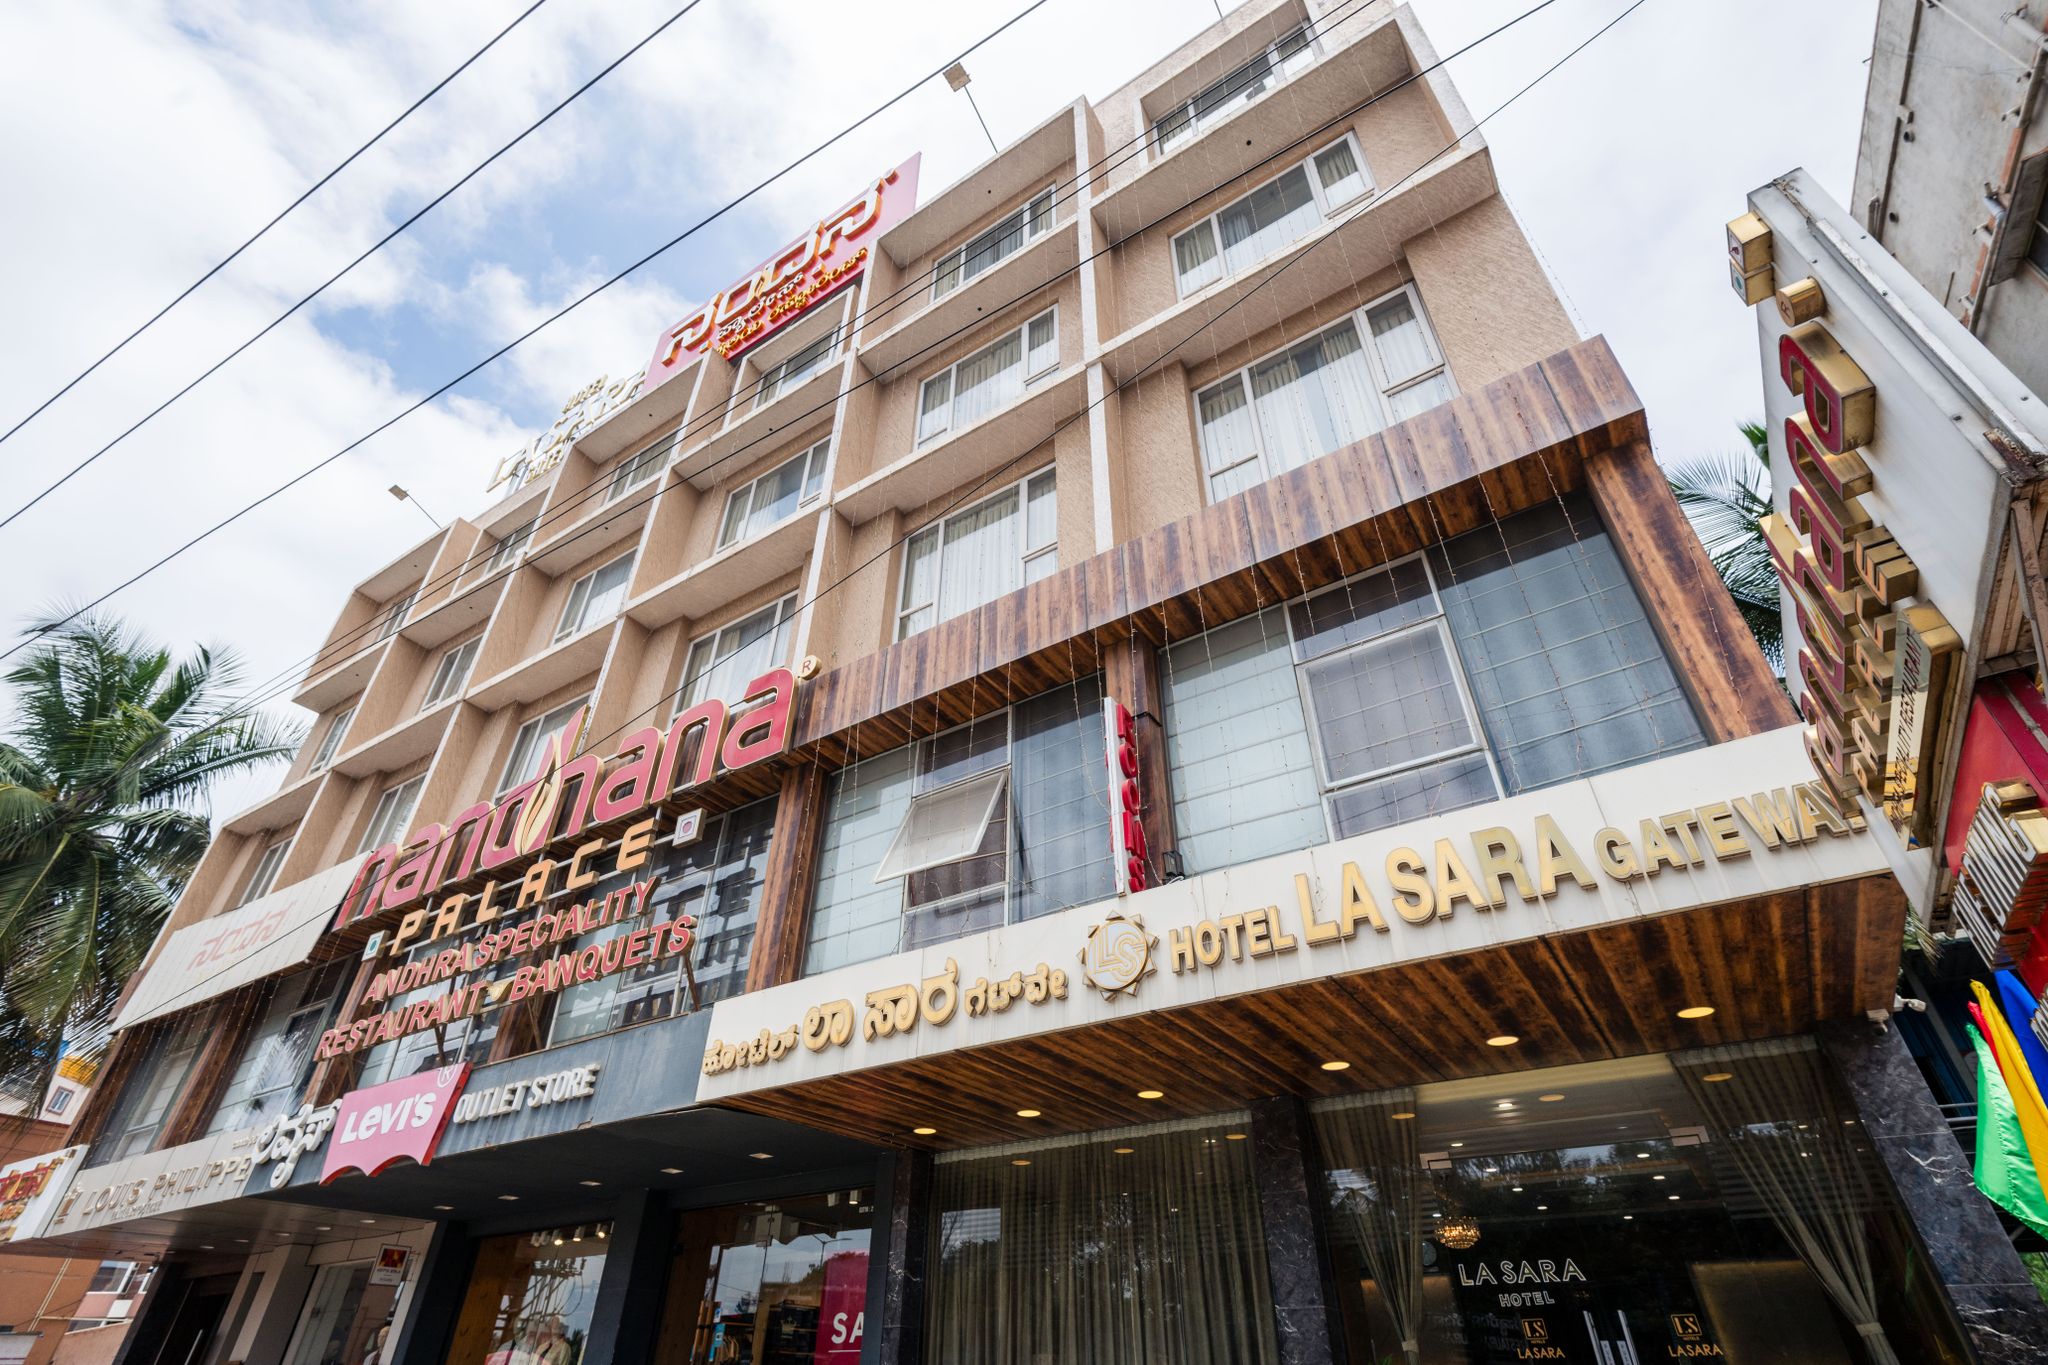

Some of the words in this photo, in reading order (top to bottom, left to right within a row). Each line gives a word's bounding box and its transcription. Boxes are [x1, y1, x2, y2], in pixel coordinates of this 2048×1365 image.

[391, 817, 658, 956] PALACE
[361, 942, 474, 1005] ANDHRA
[474, 875, 661, 965] SPECIALITY
[1168, 905, 1298, 974] HOTEL
[313, 979, 488, 1062] RESTAURANT
[510, 913, 697, 1001] BANQUETS
[453, 1080, 530, 1124] OUTLET
[527, 1063, 600, 1108] STORE
[81, 1177, 148, 1216] LOUIS
[149, 1154, 252, 1199] PHILIPPE
[1498, 1291, 1556, 1308] HOTEL
